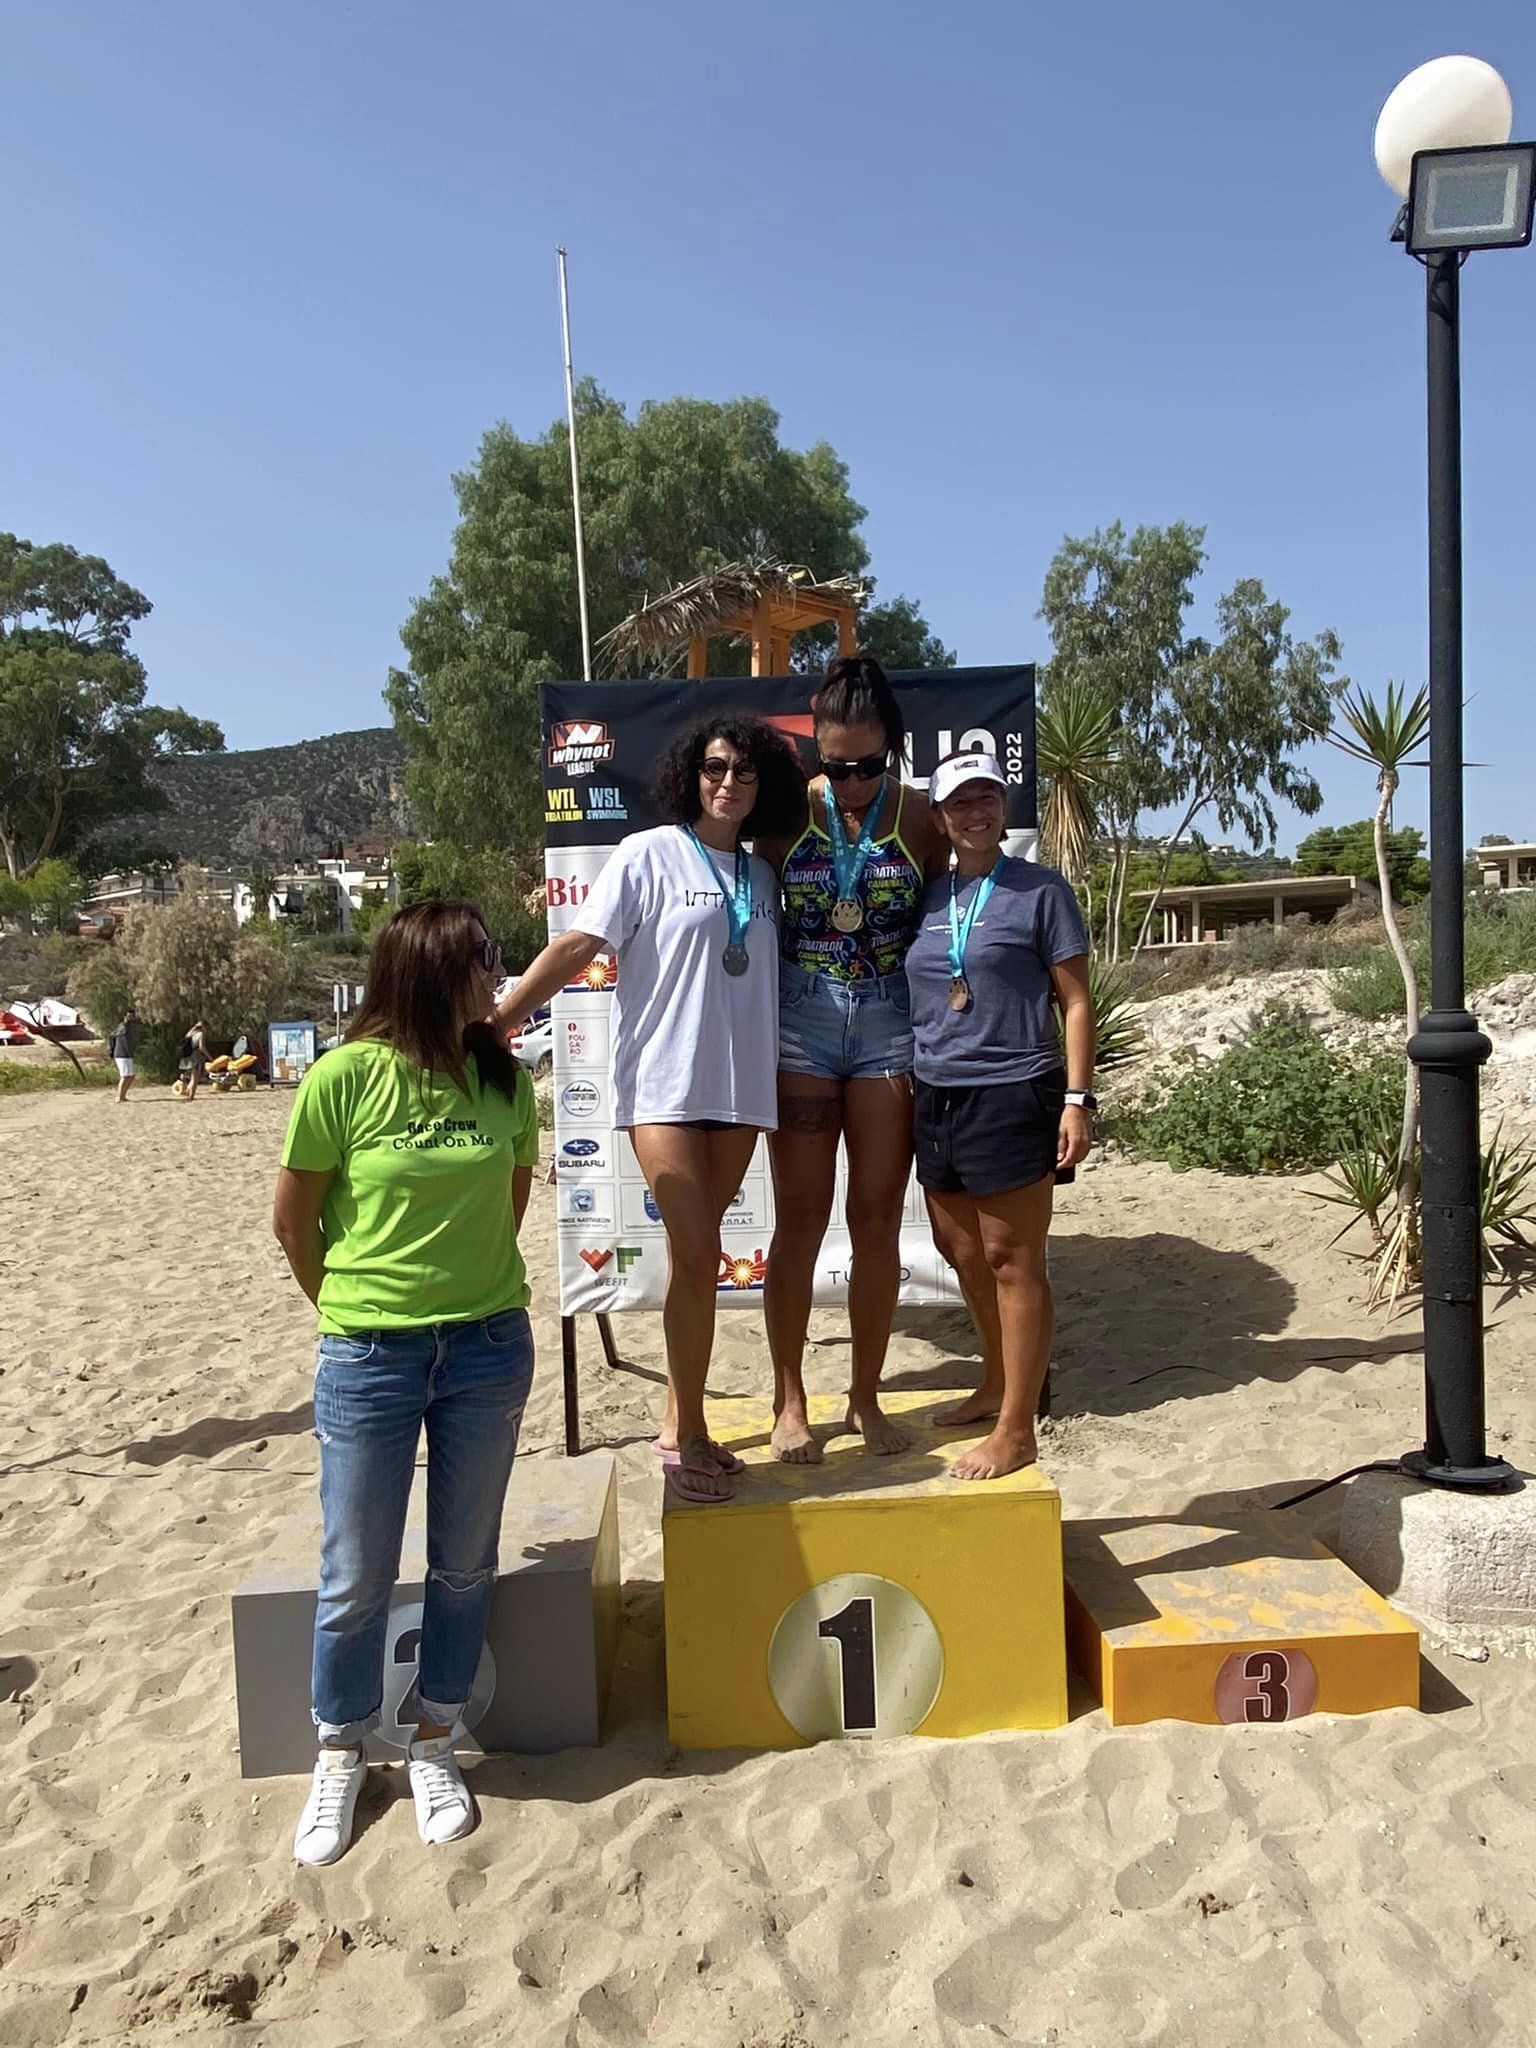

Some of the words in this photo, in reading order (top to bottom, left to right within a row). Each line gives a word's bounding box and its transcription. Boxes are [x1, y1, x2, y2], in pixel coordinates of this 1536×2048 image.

[552, 743, 611, 764] whynot
[1006, 732, 1023, 785] 2022
[567, 761, 595, 776] LEAGUE
[547, 788, 579, 810] WTL
[588, 787, 625, 808] WSL
[586, 809, 629, 820] SWIMMING
[444, 1118, 477, 1132] Crew
[393, 1136, 440, 1150] Count
[443, 1135, 467, 1148] On
[471, 1134, 494, 1146] Me
[558, 1160, 606, 1168] SUBARU
[594, 1277, 628, 1287] WEFIT
[818, 1596, 877, 1732] 1
[1243, 1650, 1290, 1722] 3
